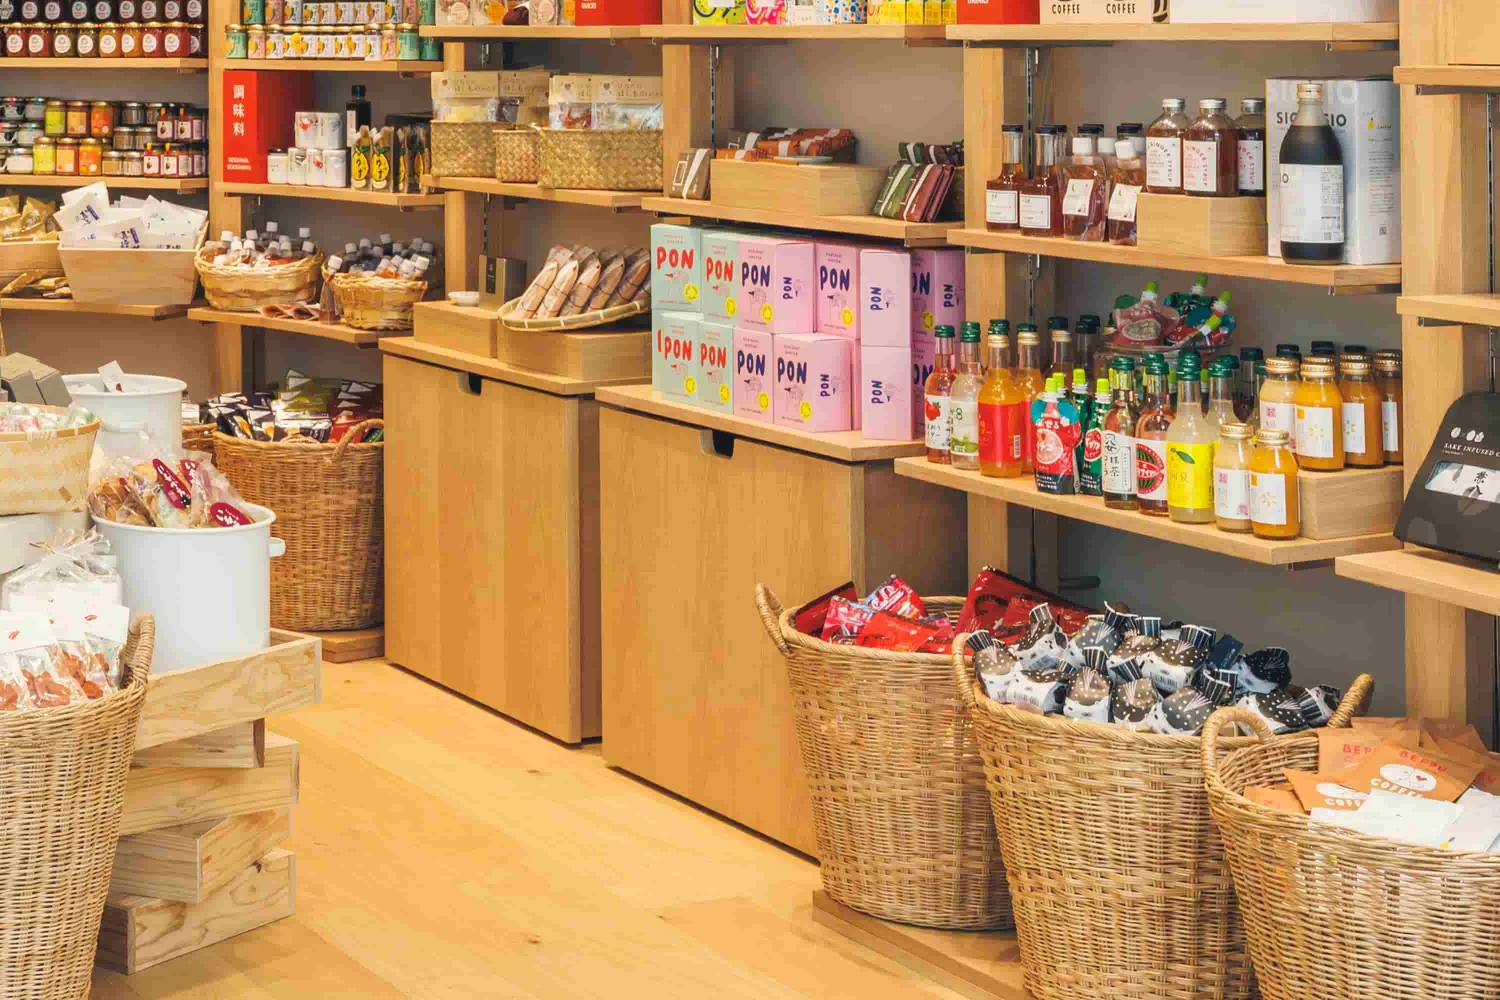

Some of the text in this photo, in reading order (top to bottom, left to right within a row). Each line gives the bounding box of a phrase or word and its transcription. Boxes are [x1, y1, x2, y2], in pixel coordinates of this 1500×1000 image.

[1051, 4, 1080, 14] COFFEE
[1106, 3, 1136, 14] COFFEE
[232, 84, 245, 137] 調味料
[656, 246, 694, 271] PON
[706, 257, 734, 282] PON
[742, 262, 770, 287] PON
[820, 265, 850, 291] PON
[782, 277, 793, 299] PON
[869, 286, 883, 311] PON
[943, 284, 954, 308] PON
[664, 336, 692, 361] PON
[700, 343, 727, 368] PON
[737, 350, 766, 376] PON
[777, 357, 807, 384] PON
[820, 374, 831, 398] PON
[871, 380, 885, 405] PON
[1444, 442, 1461, 451] SAKE
[1463, 444, 1495, 457] INFUSED
[1400, 750, 1449, 773] BEPPU
